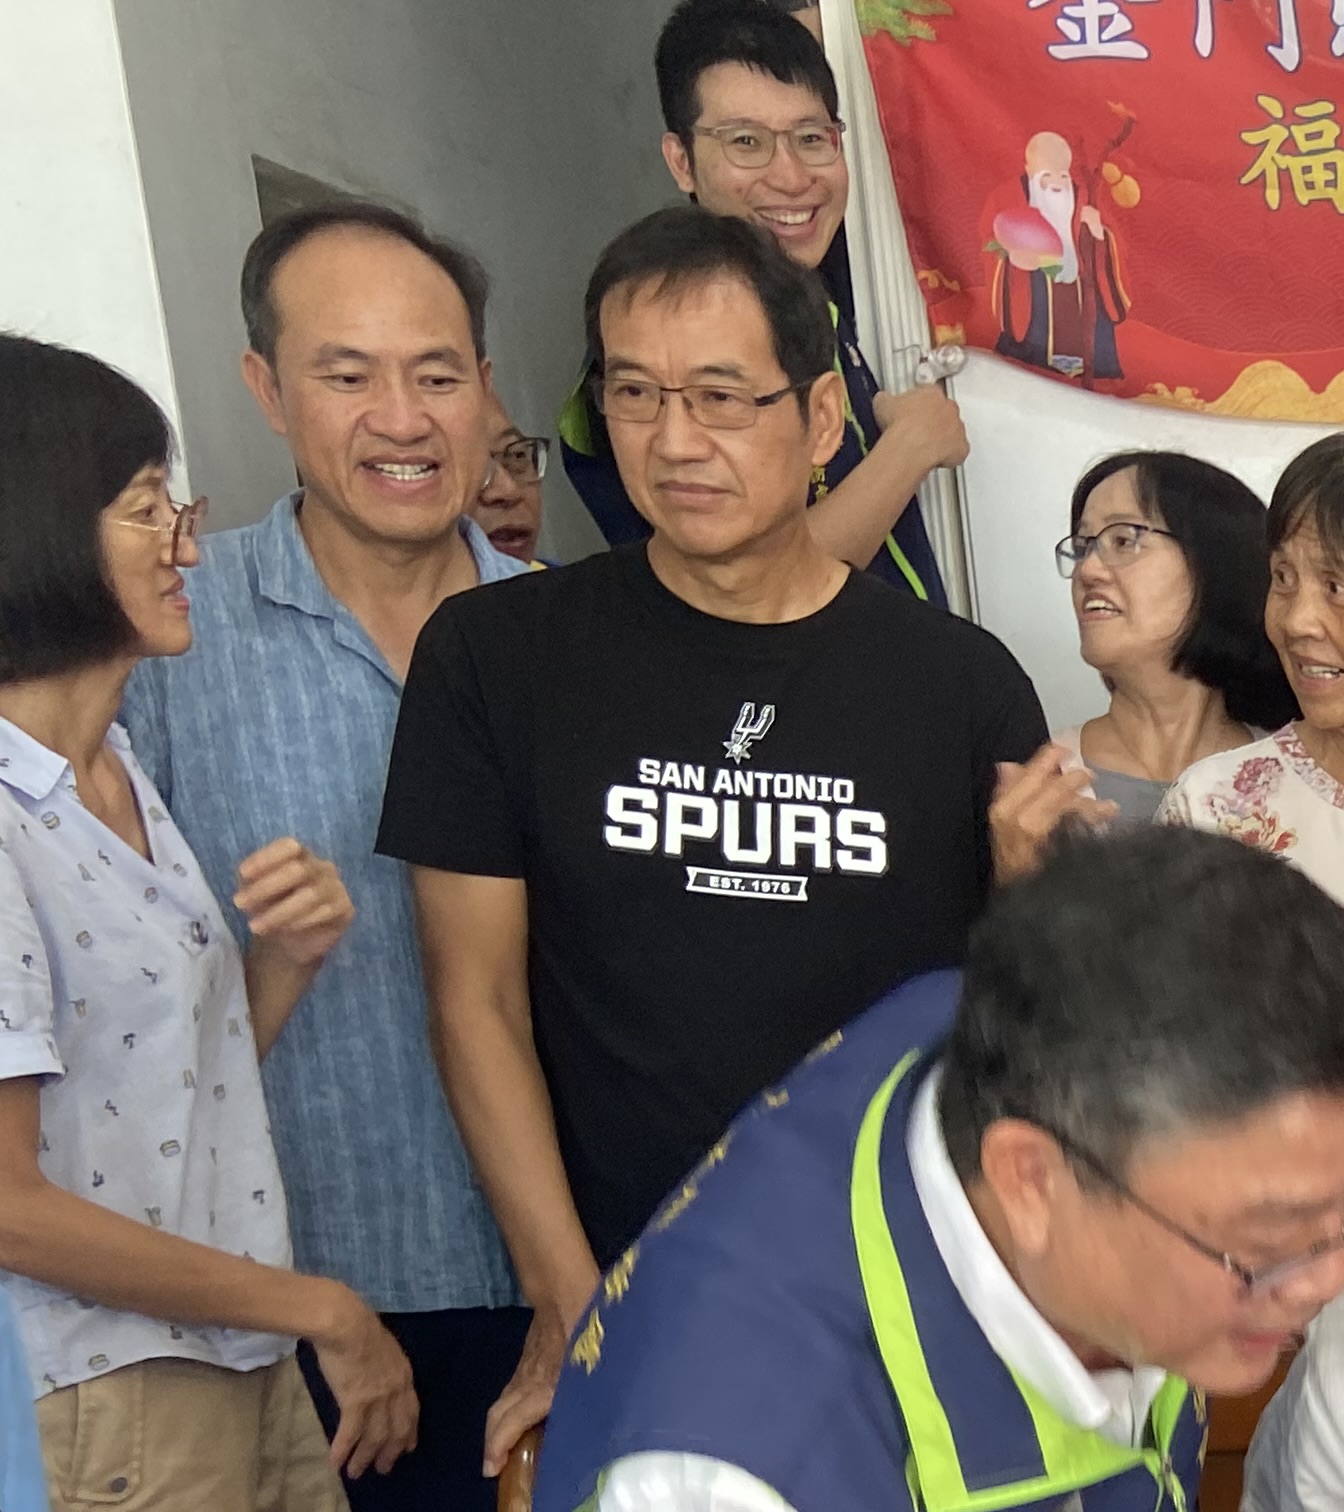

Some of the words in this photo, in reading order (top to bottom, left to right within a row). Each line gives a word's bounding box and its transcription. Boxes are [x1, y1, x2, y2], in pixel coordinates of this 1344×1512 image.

[639, 758, 705, 791] SAN
[713, 770, 855, 804] ANTONIO
[603, 784, 890, 876] SPURS
[709, 875, 746, 891] EST.
